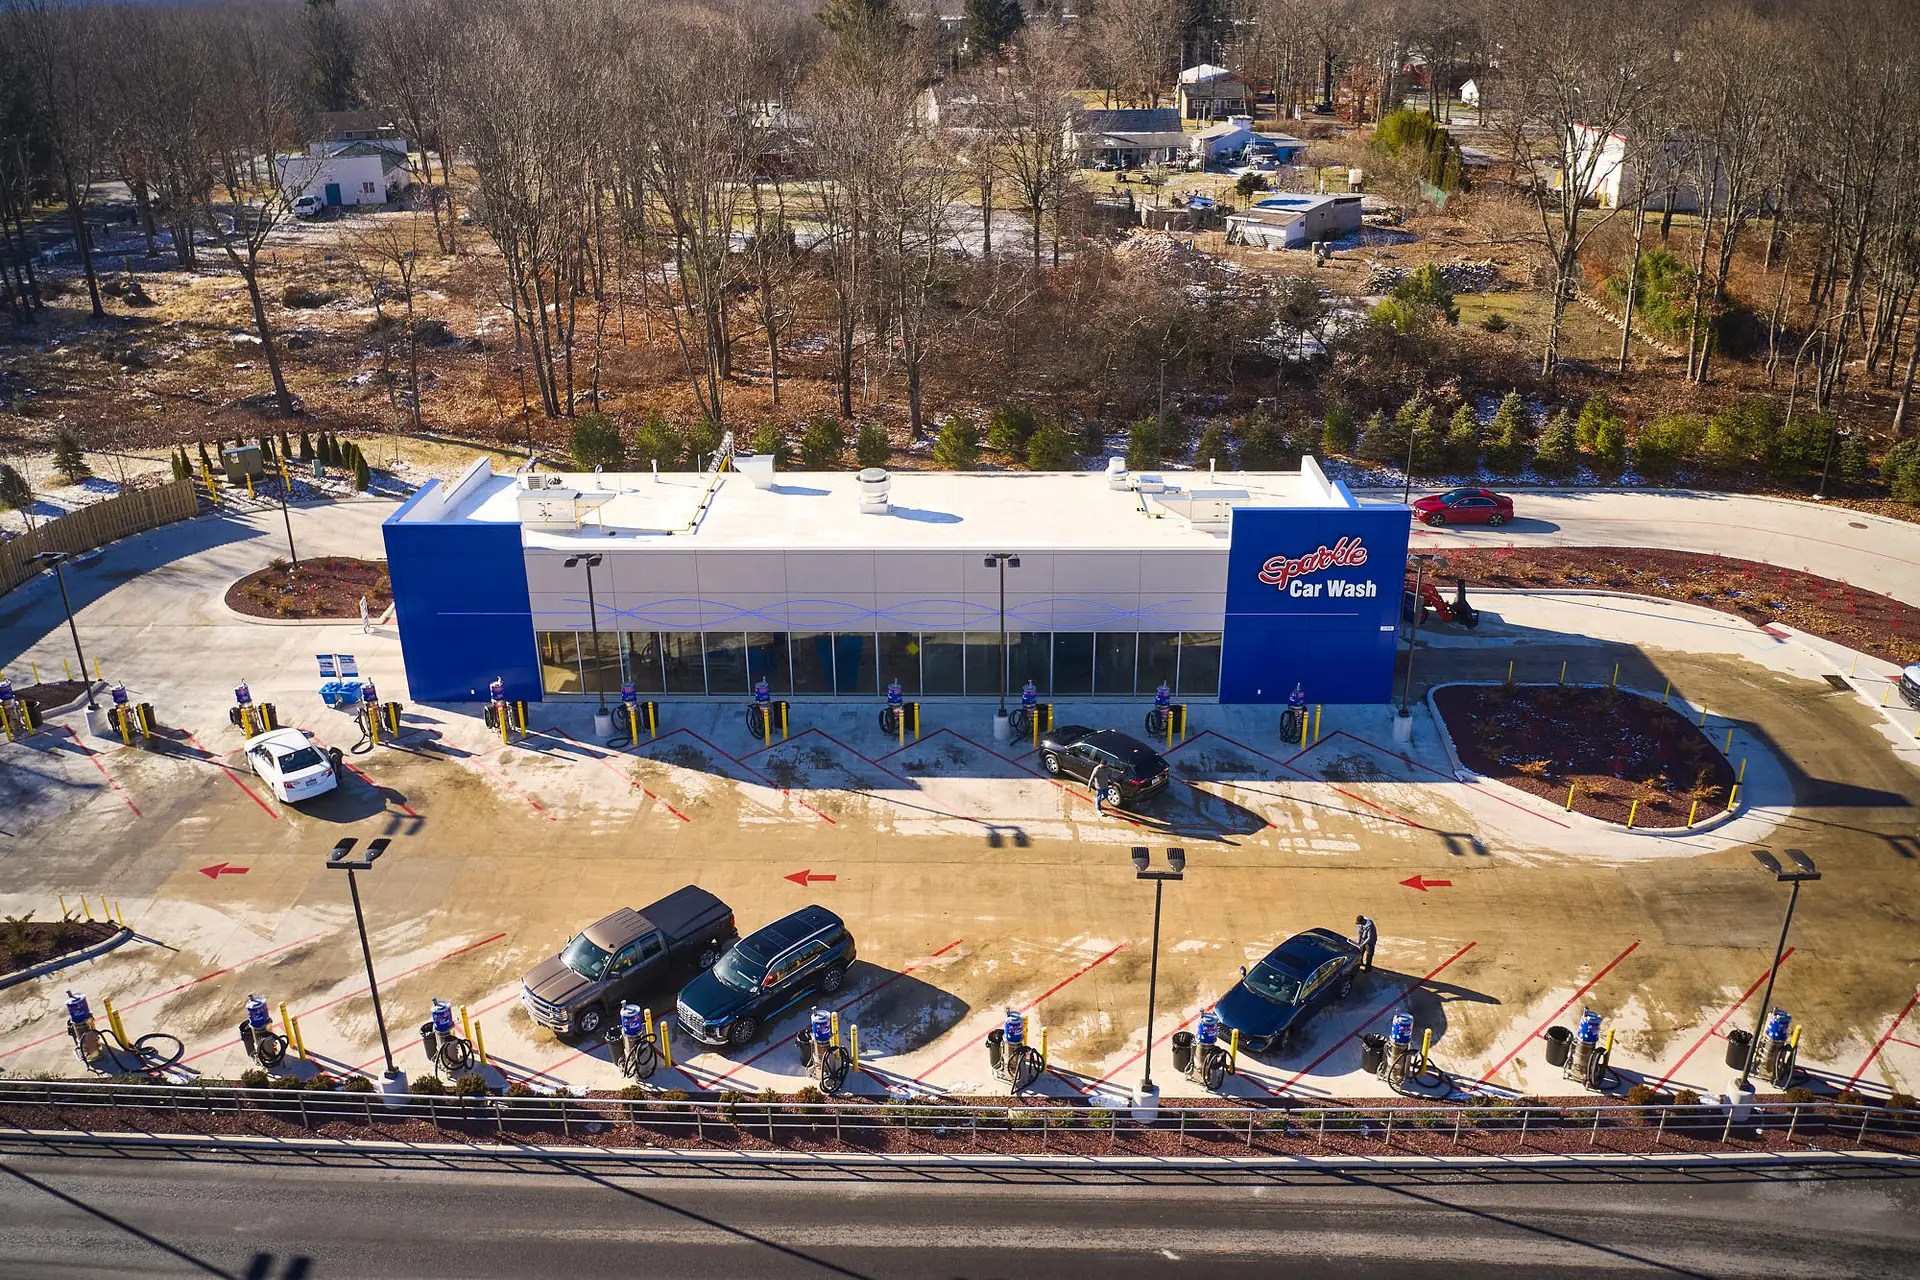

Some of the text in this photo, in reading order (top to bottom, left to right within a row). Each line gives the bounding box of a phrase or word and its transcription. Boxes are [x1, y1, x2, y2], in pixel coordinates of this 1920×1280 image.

[1258, 537, 1367, 590] Sparkle
[1289, 580, 1377, 597] Car Wash
